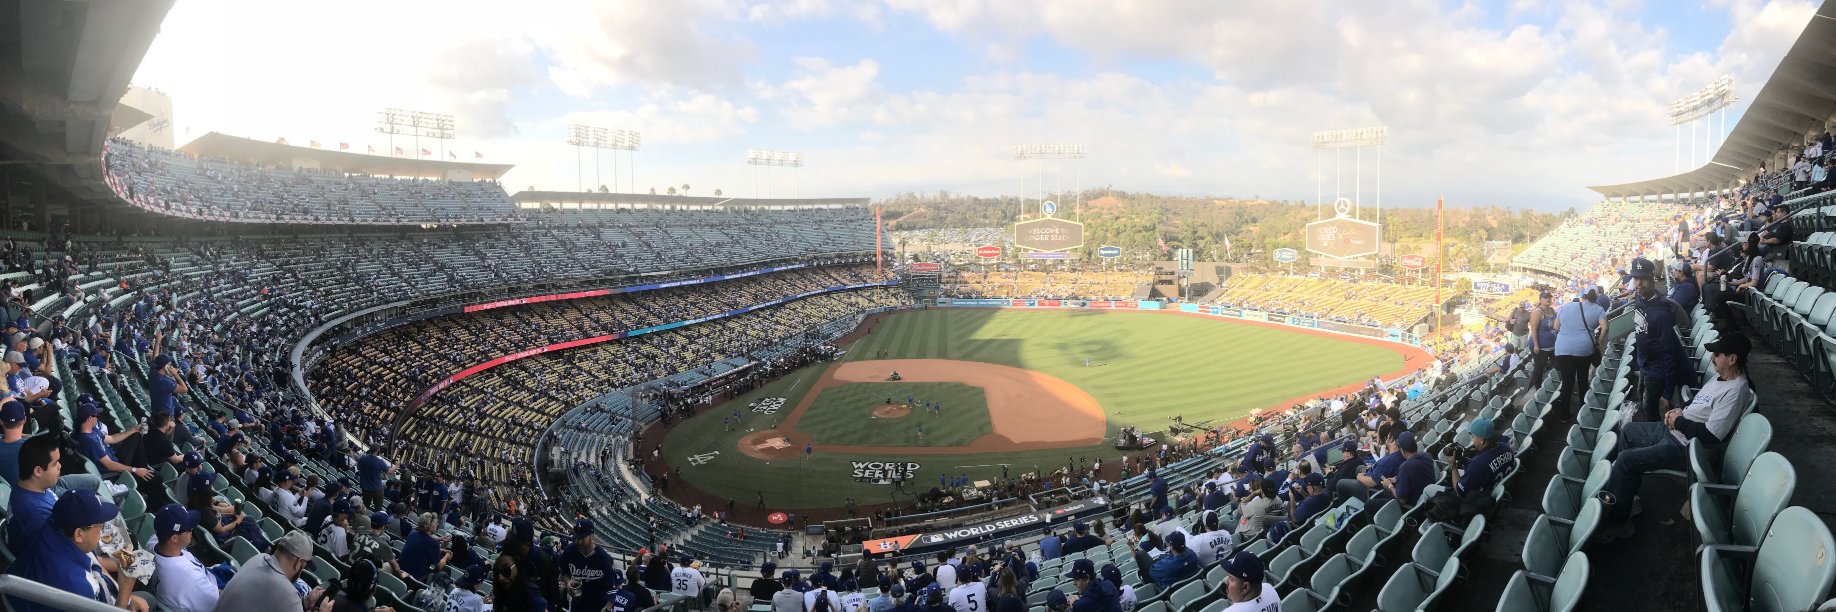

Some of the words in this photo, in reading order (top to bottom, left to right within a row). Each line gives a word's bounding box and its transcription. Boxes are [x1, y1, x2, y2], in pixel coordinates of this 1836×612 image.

[851, 461, 921, 471] WORD
[944, 524, 997, 540] WORLD
[998, 514, 1038, 529] SERIES
[568, 563, 604, 583] Dodgers
[676, 578, 689, 591] 35
[966, 593, 979, 612] 5
